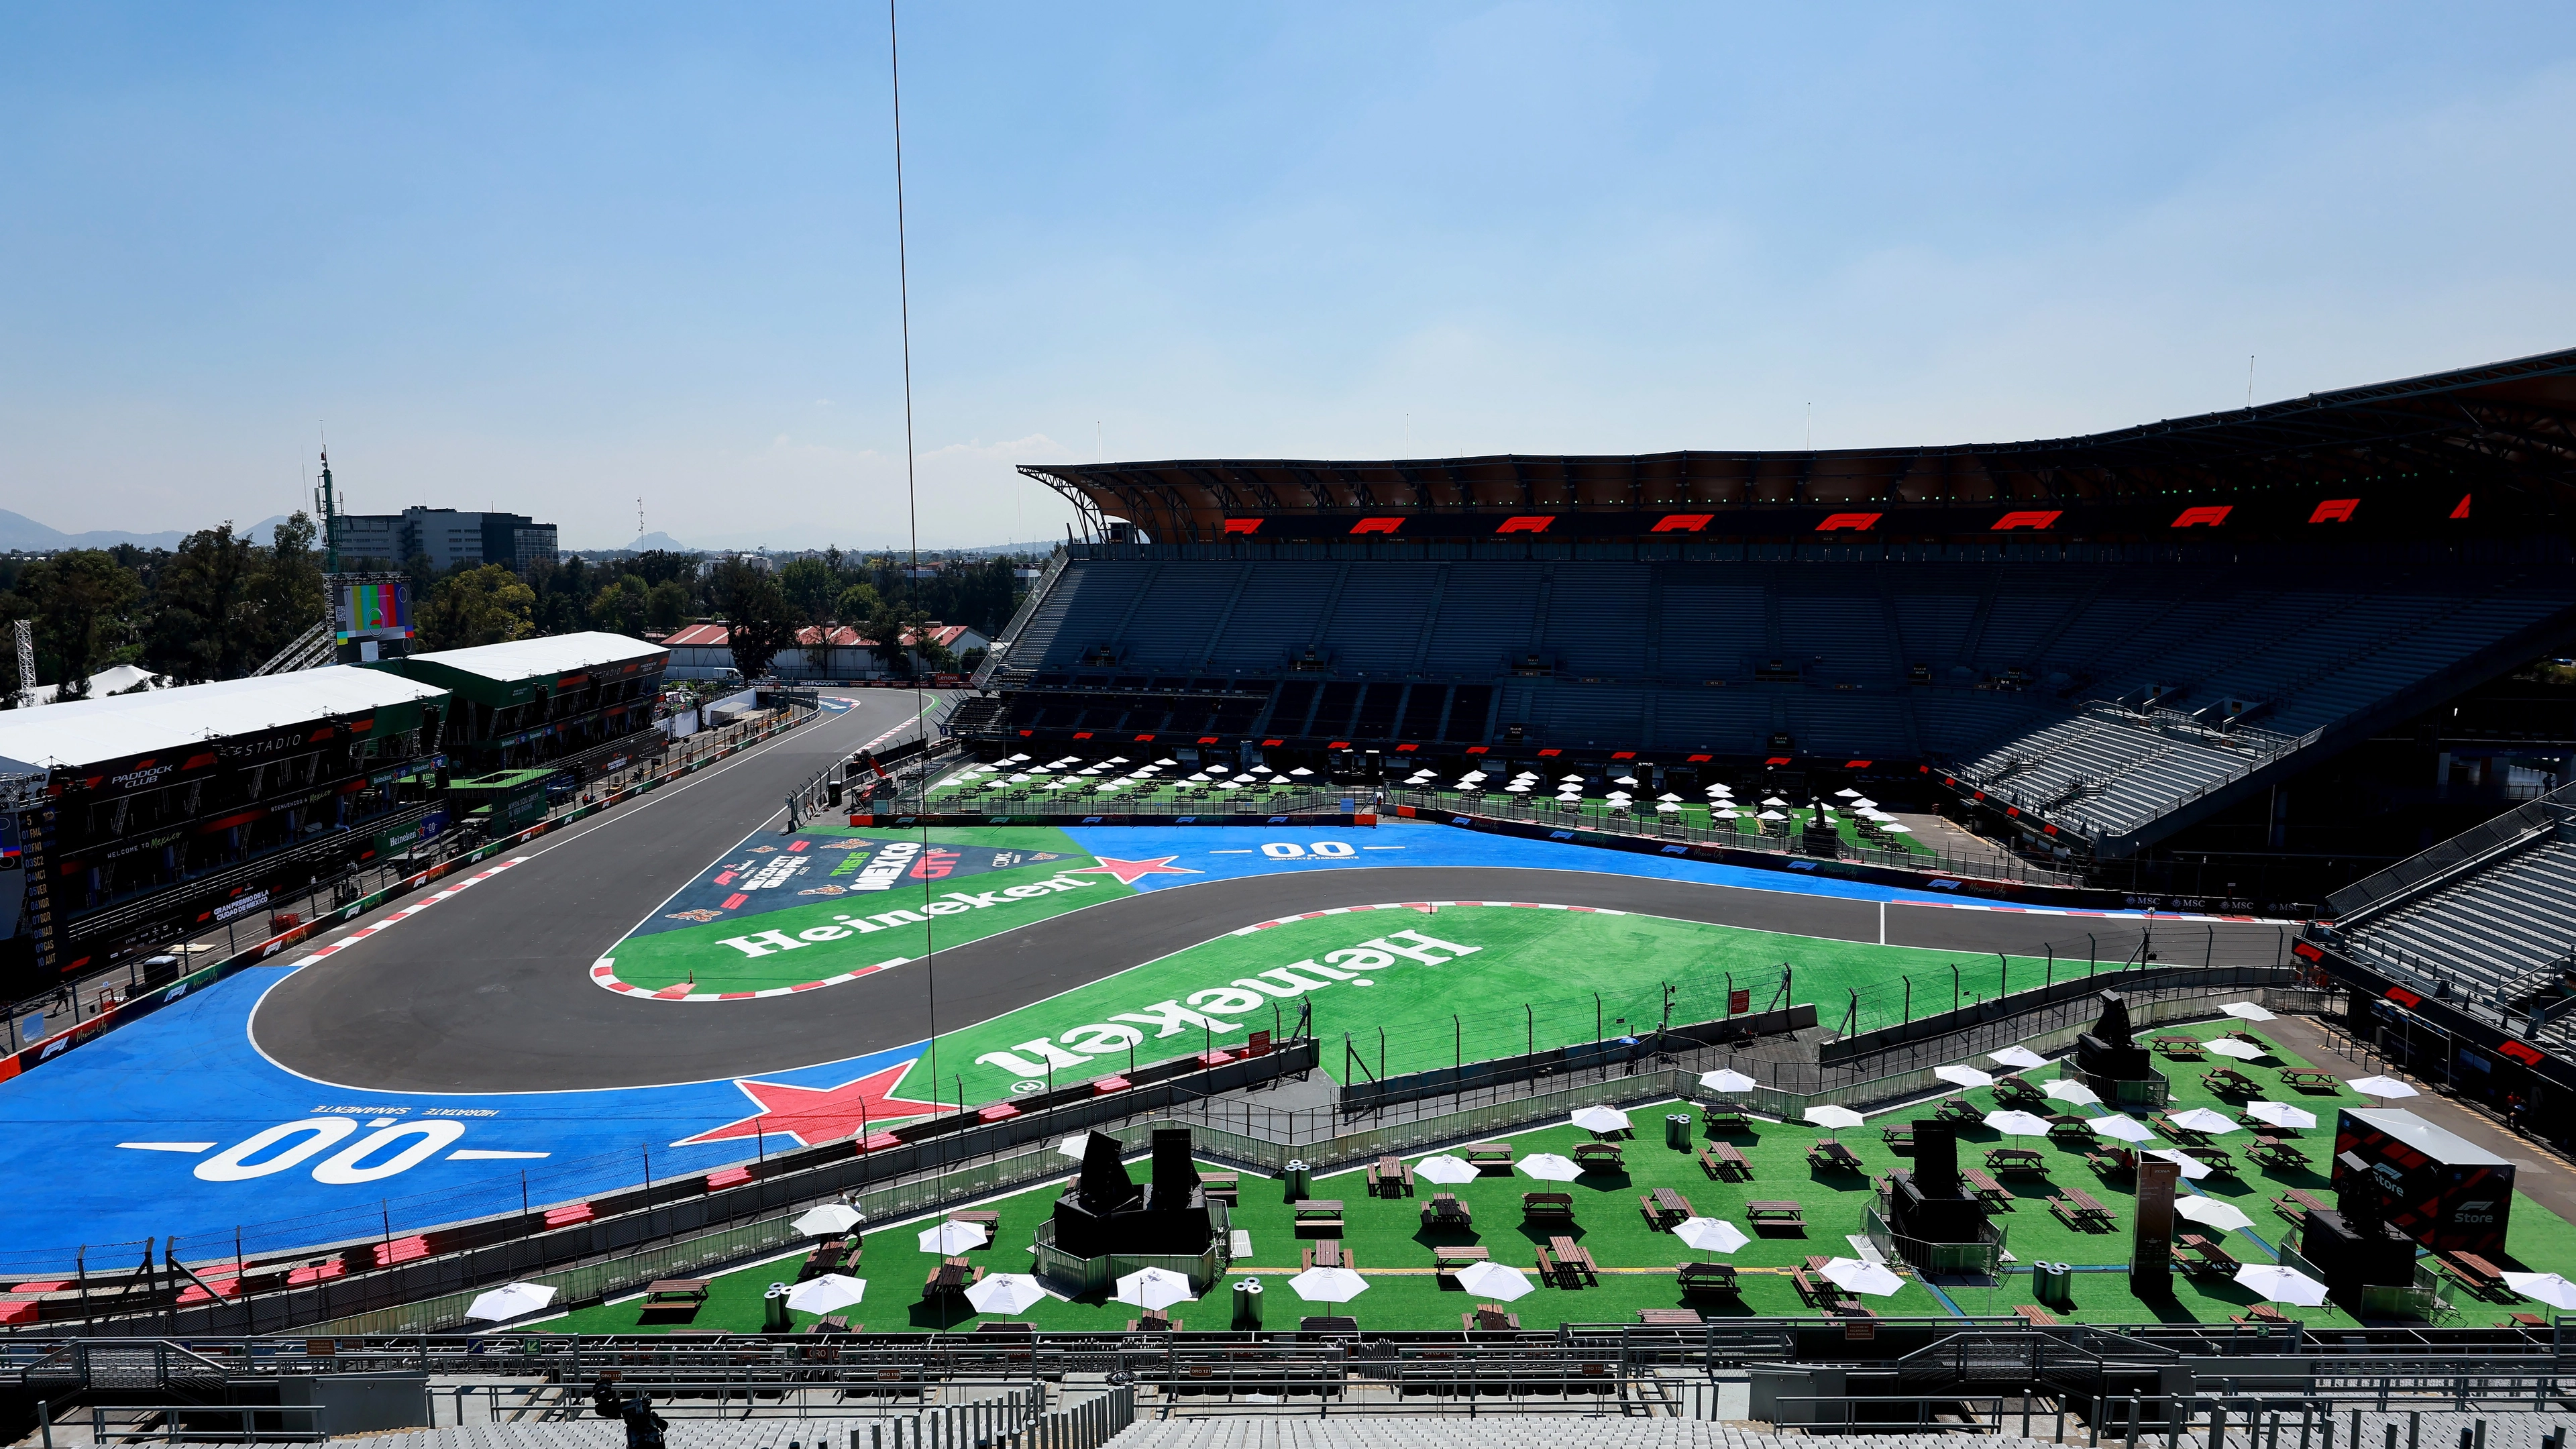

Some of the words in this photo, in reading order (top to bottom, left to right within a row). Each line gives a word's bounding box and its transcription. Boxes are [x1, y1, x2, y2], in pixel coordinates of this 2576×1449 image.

[2171, 506, 2233, 527] F1
[2308, 498, 2360, 523] F1
[1349, 517, 1406, 533] F1
[1495, 516, 1556, 533] F1
[1651, 515, 1715, 532] F1
[1815, 513, 1883, 531] F1
[1990, 511, 2063, 530] F1
[111, 764, 173, 784] PADDOCK
[413, 763, 430, 773] Heineken
[124, 775, 158, 788] CLUB
[374, 773, 392, 785] Heineken
[270, 799, 303, 812] BIENVENIDO
[309, 789, 332, 804] Mexico
[27, 815, 32, 826] 5
[1452, 816, 1472, 826] F1
[22, 830, 29, 839] 01
[30, 827, 42, 839] FM4
[390, 828, 417, 847] Heineken
[521, 832, 531, 843] F1
[1549, 830, 1574, 840] F1
[23, 844, 32, 854] 02
[32, 841, 42, 853] FM1
[107, 845, 138, 859] WELCOME
[150, 830, 182, 849] Mexico
[1260, 841, 1356, 858] 0.0
[1660, 845, 1689, 855] F1
[1694, 848, 1713, 858] Mexico
[1713, 849, 1724, 861] City
[25, 858, 34, 868] 03
[33, 855, 44, 867] SC2
[470, 851, 483, 863] F1
[739, 867, 779, 890] MEXICO
[767, 855, 794, 867] CITY
[761, 867, 797, 888] GRAND
[783, 855, 812, 868] PRIX
[829, 859, 865, 876] THIS
[849, 842, 922, 891] MEXICO
[908, 853, 961, 879] CITY
[1786, 861, 1817, 871] F1
[1823, 865, 1845, 875] Mexico
[1846, 865, 1858, 879] City
[27, 872, 36, 882] 04
[35, 869, 46, 881] MC1
[413, 875, 427, 888] F1
[29, 887, 37, 897] 05
[36, 883, 47, 896] VER
[1927, 879, 1962, 890] F1
[1968, 883, 1992, 894] Mexico
[1993, 884, 2008, 898] City
[30, 900, 38, 910] 06
[38, 898, 50, 909] NOR
[214, 904, 231, 915] GRAN
[231, 896, 253, 908] PREMIO
[217, 908, 237, 921] CIUDAD
[238, 904, 246, 912] DE
[246, 896, 268, 909] MEXICO
[344, 904, 361, 919] F1
[364, 898, 376, 910] Mexico
[2137, 897, 2161, 906] MSC
[2183, 899, 2206, 908] MSC
[2231, 902, 2254, 910] MSC
[2279, 903, 2302, 912] MSC
[32, 914, 40, 925] 07
[40, 912, 51, 923] BOR
[716, 874, 1097, 958] Heineken
[34, 928, 42, 939] 08
[42, 926, 52, 938] HAD
[36, 943, 44, 953] 09
[43, 940, 54, 951] GAS
[262, 939, 282, 957] F1
[286, 934, 300, 945] Mexico
[300, 926, 308, 941] City
[37, 957, 44, 967] 10
[46, 953, 56, 965] ANT
[2294, 943, 2323, 962] F1
[163, 982, 189, 1003] F1
[193, 977, 208, 989] Mexico
[209, 969, 218, 983] City
[975, 930, 1484, 1077] Heineken
[2385, 987, 2421, 1008] F1
[40, 1036, 70, 1061] F1
[76, 1028, 96, 1042] Mexico
[97, 1017, 108, 1035] City
[2498, 1040, 2544, 1066] F1
[310, 1105, 412, 1116] SANAMENTE
[423, 1108, 500, 1118] HIDRATATE
[193, 1116, 466, 1185] 0.0
[2373, 1162, 2403, 1180] F1
[2374, 1171, 2404, 1197] Store
[2457, 1201, 2495, 1211] F1
[2455, 1213, 2493, 1223] Store
